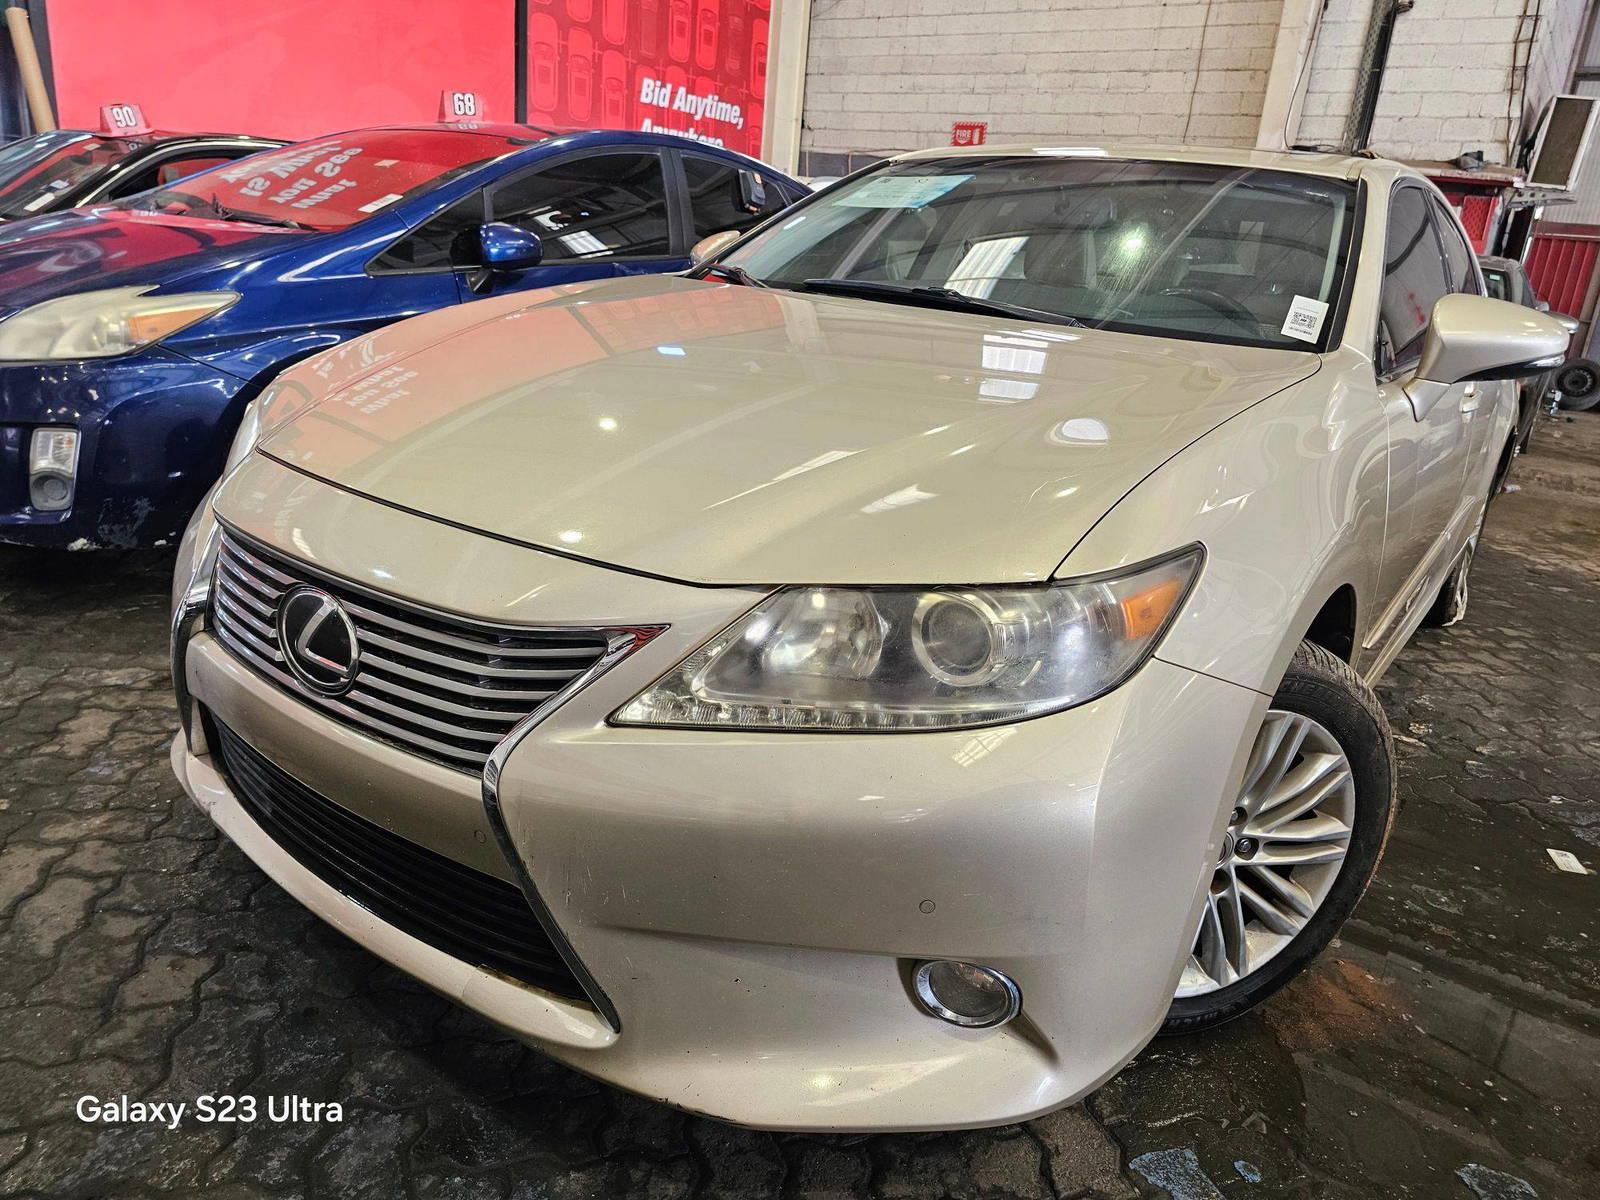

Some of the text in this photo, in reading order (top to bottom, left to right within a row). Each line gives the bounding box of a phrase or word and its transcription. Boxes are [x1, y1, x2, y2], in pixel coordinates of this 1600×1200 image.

[453, 92, 476, 116] 68
[640, 77, 744, 130] Bid Anytime,
[112, 105, 137, 128] 90
